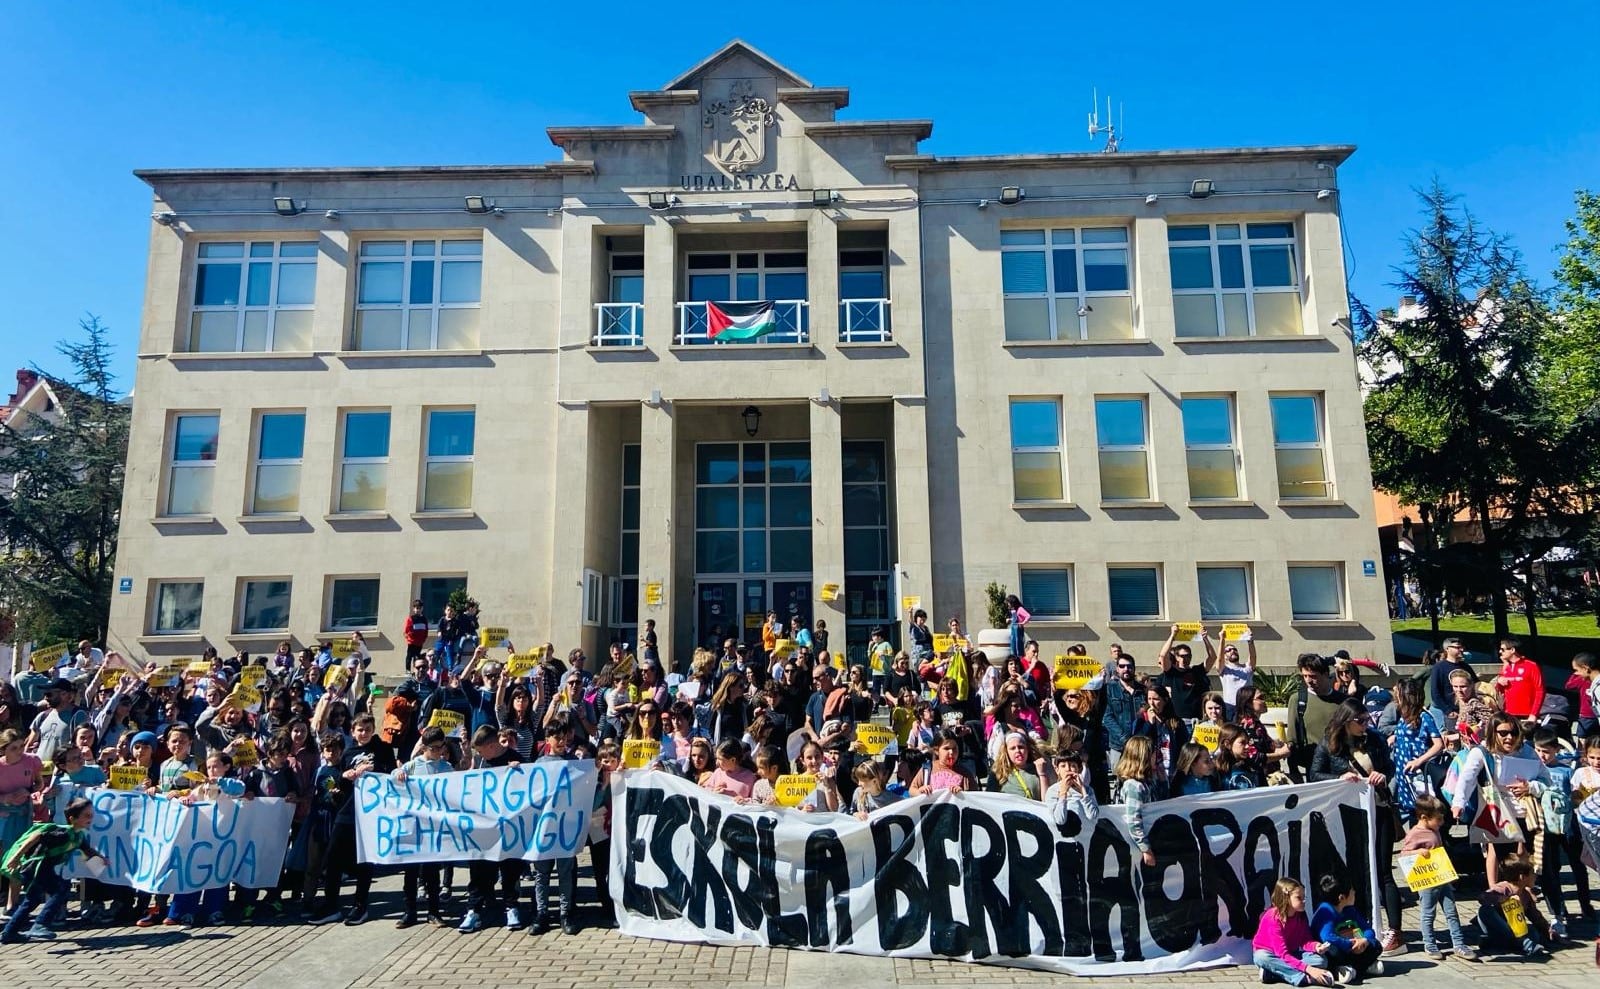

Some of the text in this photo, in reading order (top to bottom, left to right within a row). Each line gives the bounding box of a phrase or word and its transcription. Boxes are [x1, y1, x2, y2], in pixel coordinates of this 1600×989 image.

[681, 174, 800, 191] UDALETXEA
[43, 653, 63, 663] ORAIN
[1056, 658, 1079, 666] ESKOLA
[1066, 669, 1093, 679] ORAIN
[437, 720, 457, 728] ORAIN
[859, 725, 878, 733] ESKOLA
[867, 735, 890, 745] ORAIN
[1203, 735, 1217, 743] ORA
[632, 751, 653, 761] ORAIN
[119, 777, 139, 786] ORAIN
[785, 787, 809, 797] ORAIN
[377, 810, 584, 858] BEHAR DUGU
[623, 786, 854, 947] ESKOLA
[1412, 862, 1439, 876] ORAIN
[1409, 877, 1432, 889] BERRIA
